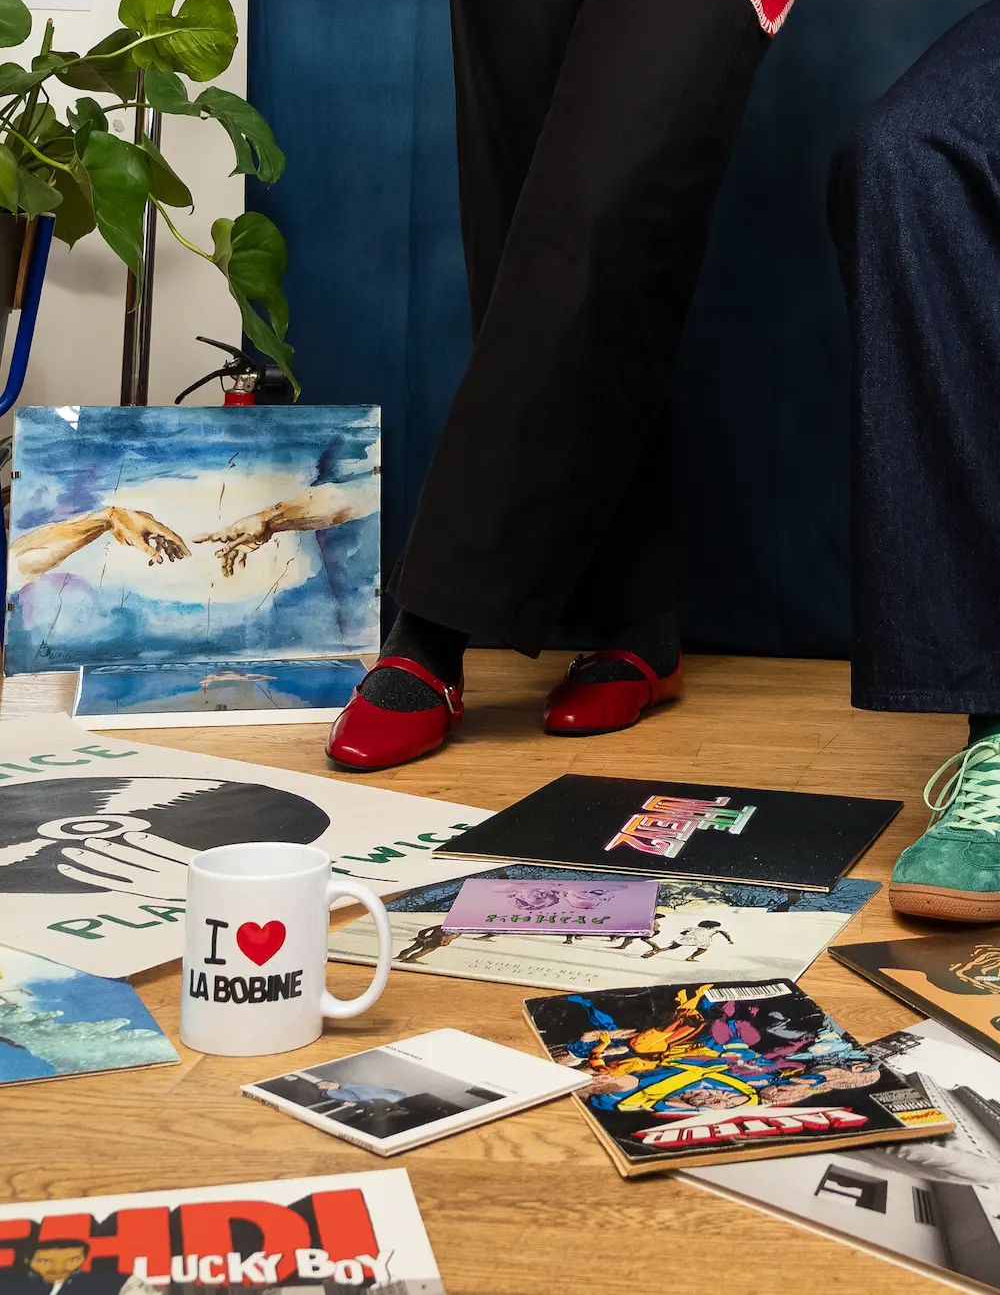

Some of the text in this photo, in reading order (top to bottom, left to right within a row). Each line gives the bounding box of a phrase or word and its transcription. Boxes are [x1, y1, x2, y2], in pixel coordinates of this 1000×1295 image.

[47, 898, 187, 939] PLA
[203, 917, 229, 966] I
[189, 969, 303, 1004] LA BOBINE
[641, 1108, 869, 1146] FACTEUR
[134, 1247, 395, 1289] LUCKY BOY
